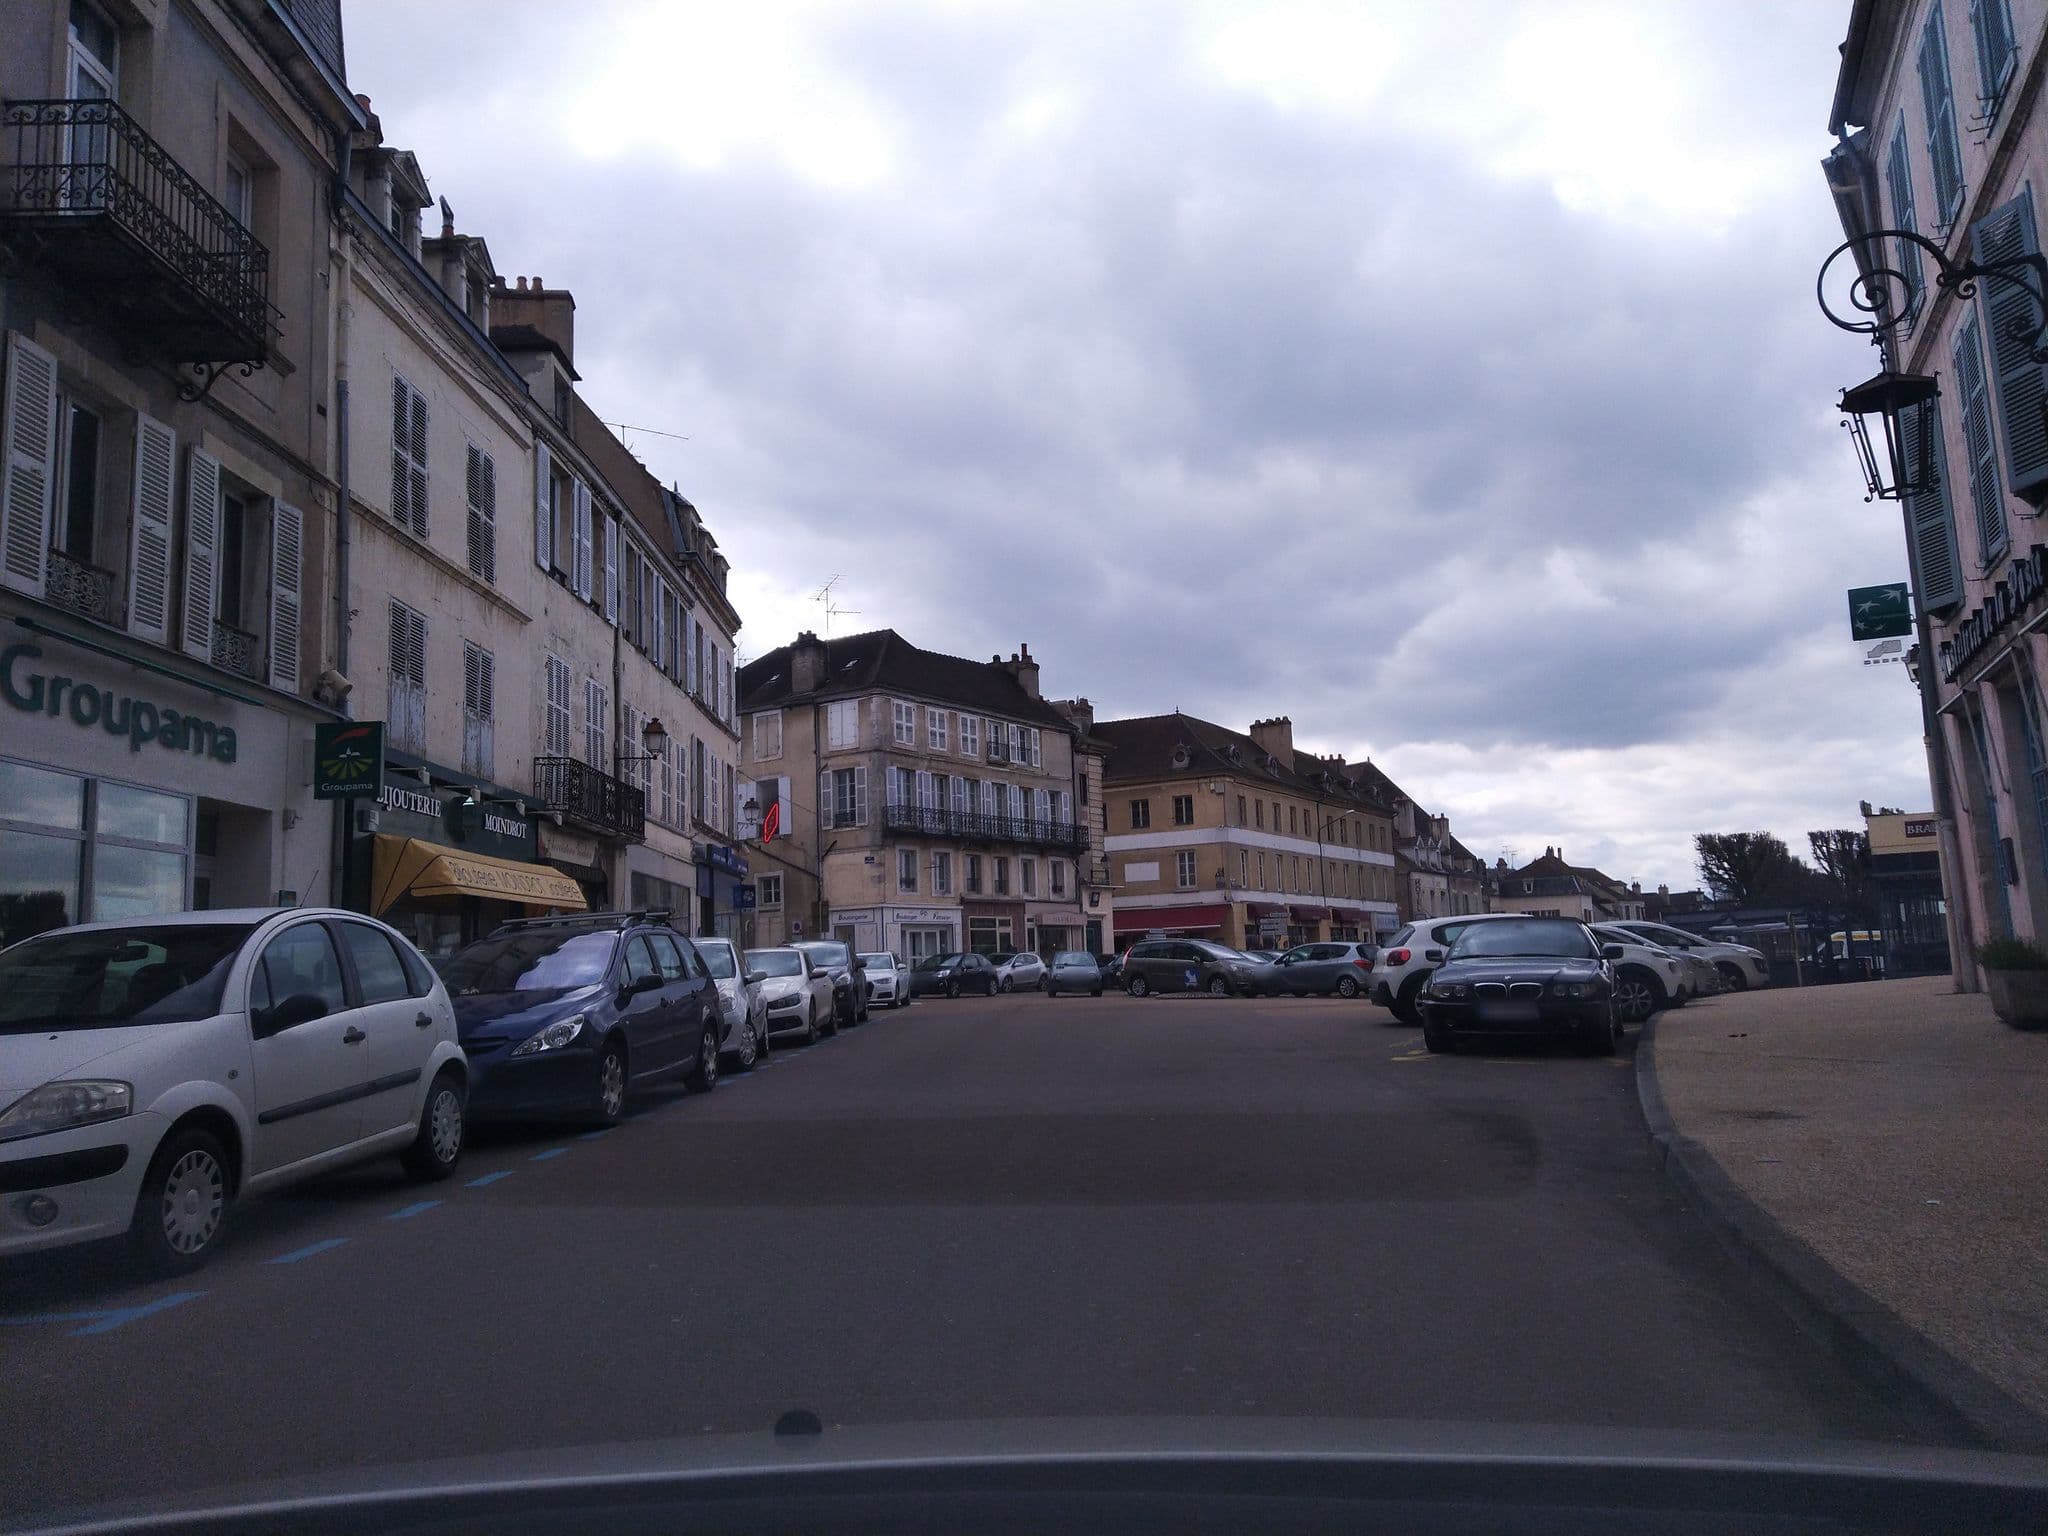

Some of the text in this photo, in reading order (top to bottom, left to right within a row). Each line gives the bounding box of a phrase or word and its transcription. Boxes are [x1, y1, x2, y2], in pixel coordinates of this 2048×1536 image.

[0, 644, 238, 763] Groupama
[321, 782, 373, 793] Groupama
[376, 784, 528, 839] IJOUTERIE MOINDROT
